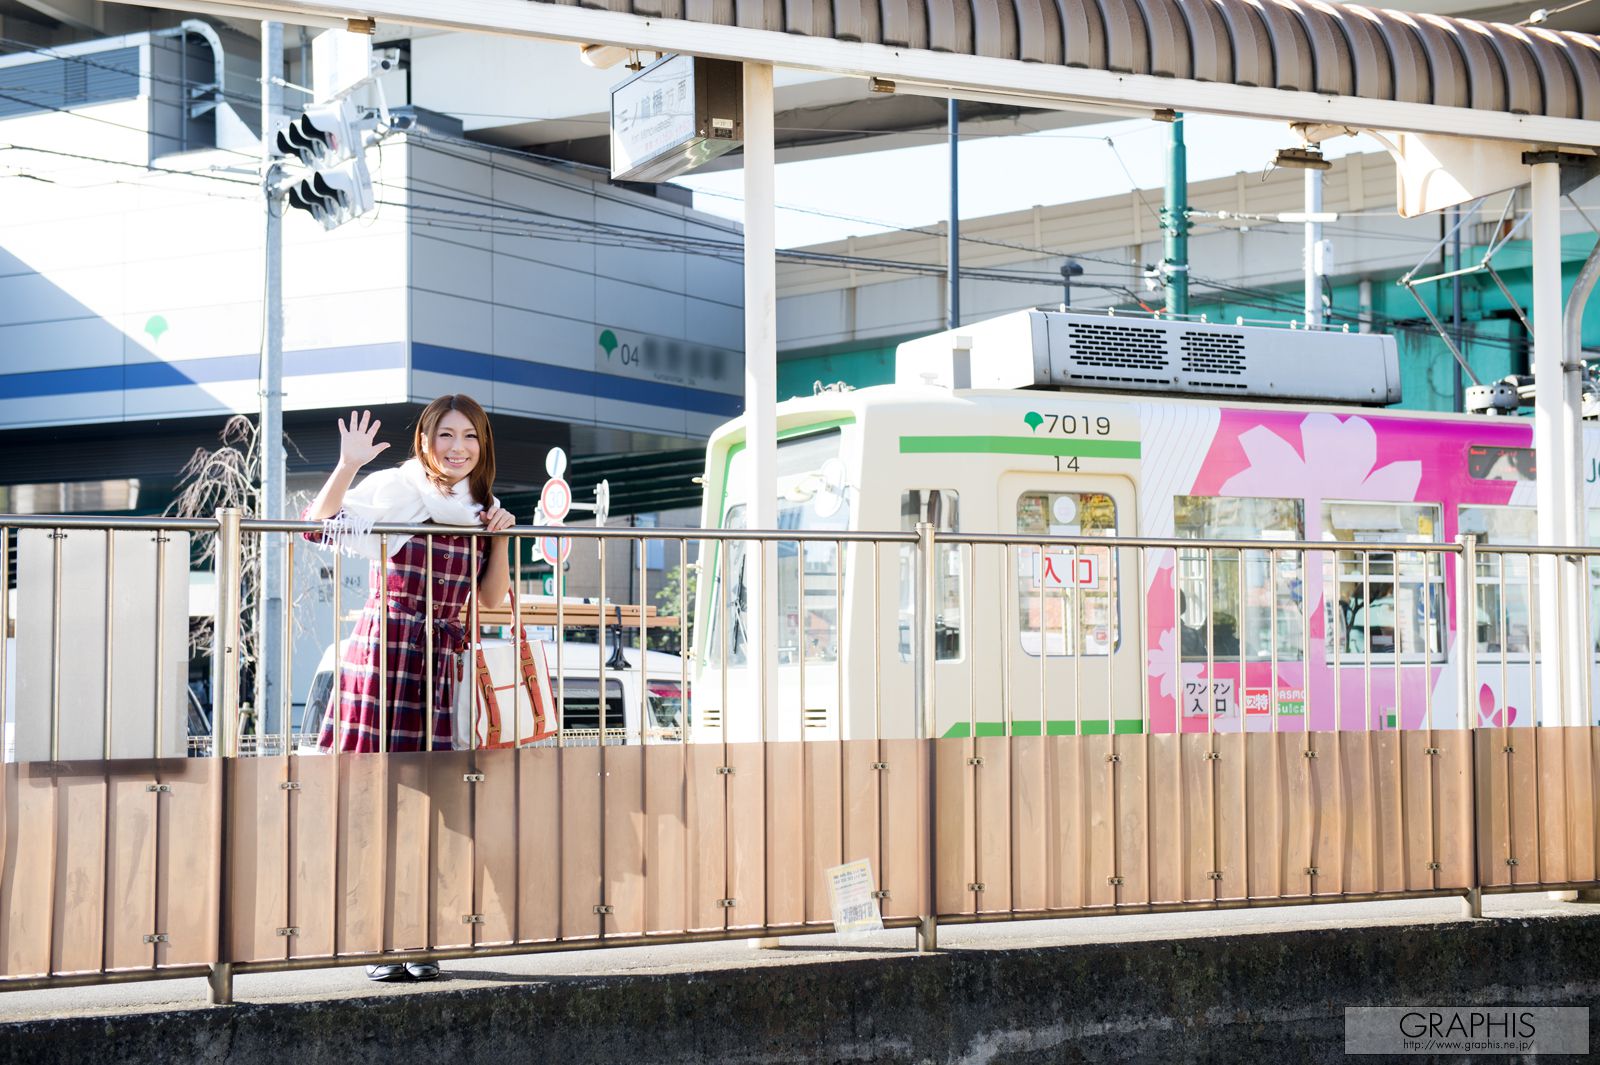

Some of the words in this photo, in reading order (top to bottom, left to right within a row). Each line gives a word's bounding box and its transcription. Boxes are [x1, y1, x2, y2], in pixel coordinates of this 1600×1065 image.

[621, 343, 639, 367] 04
[1044, 413, 1111, 436] 7019
[1054, 455, 1080, 472] 14
[1585, 458, 1600, 483] J
[548, 491, 564, 508] 30
[1038, 557, 1093, 584] 入口
[1186, 683, 1231, 695] ワンマン
[1192, 699, 1226, 712] 入口
